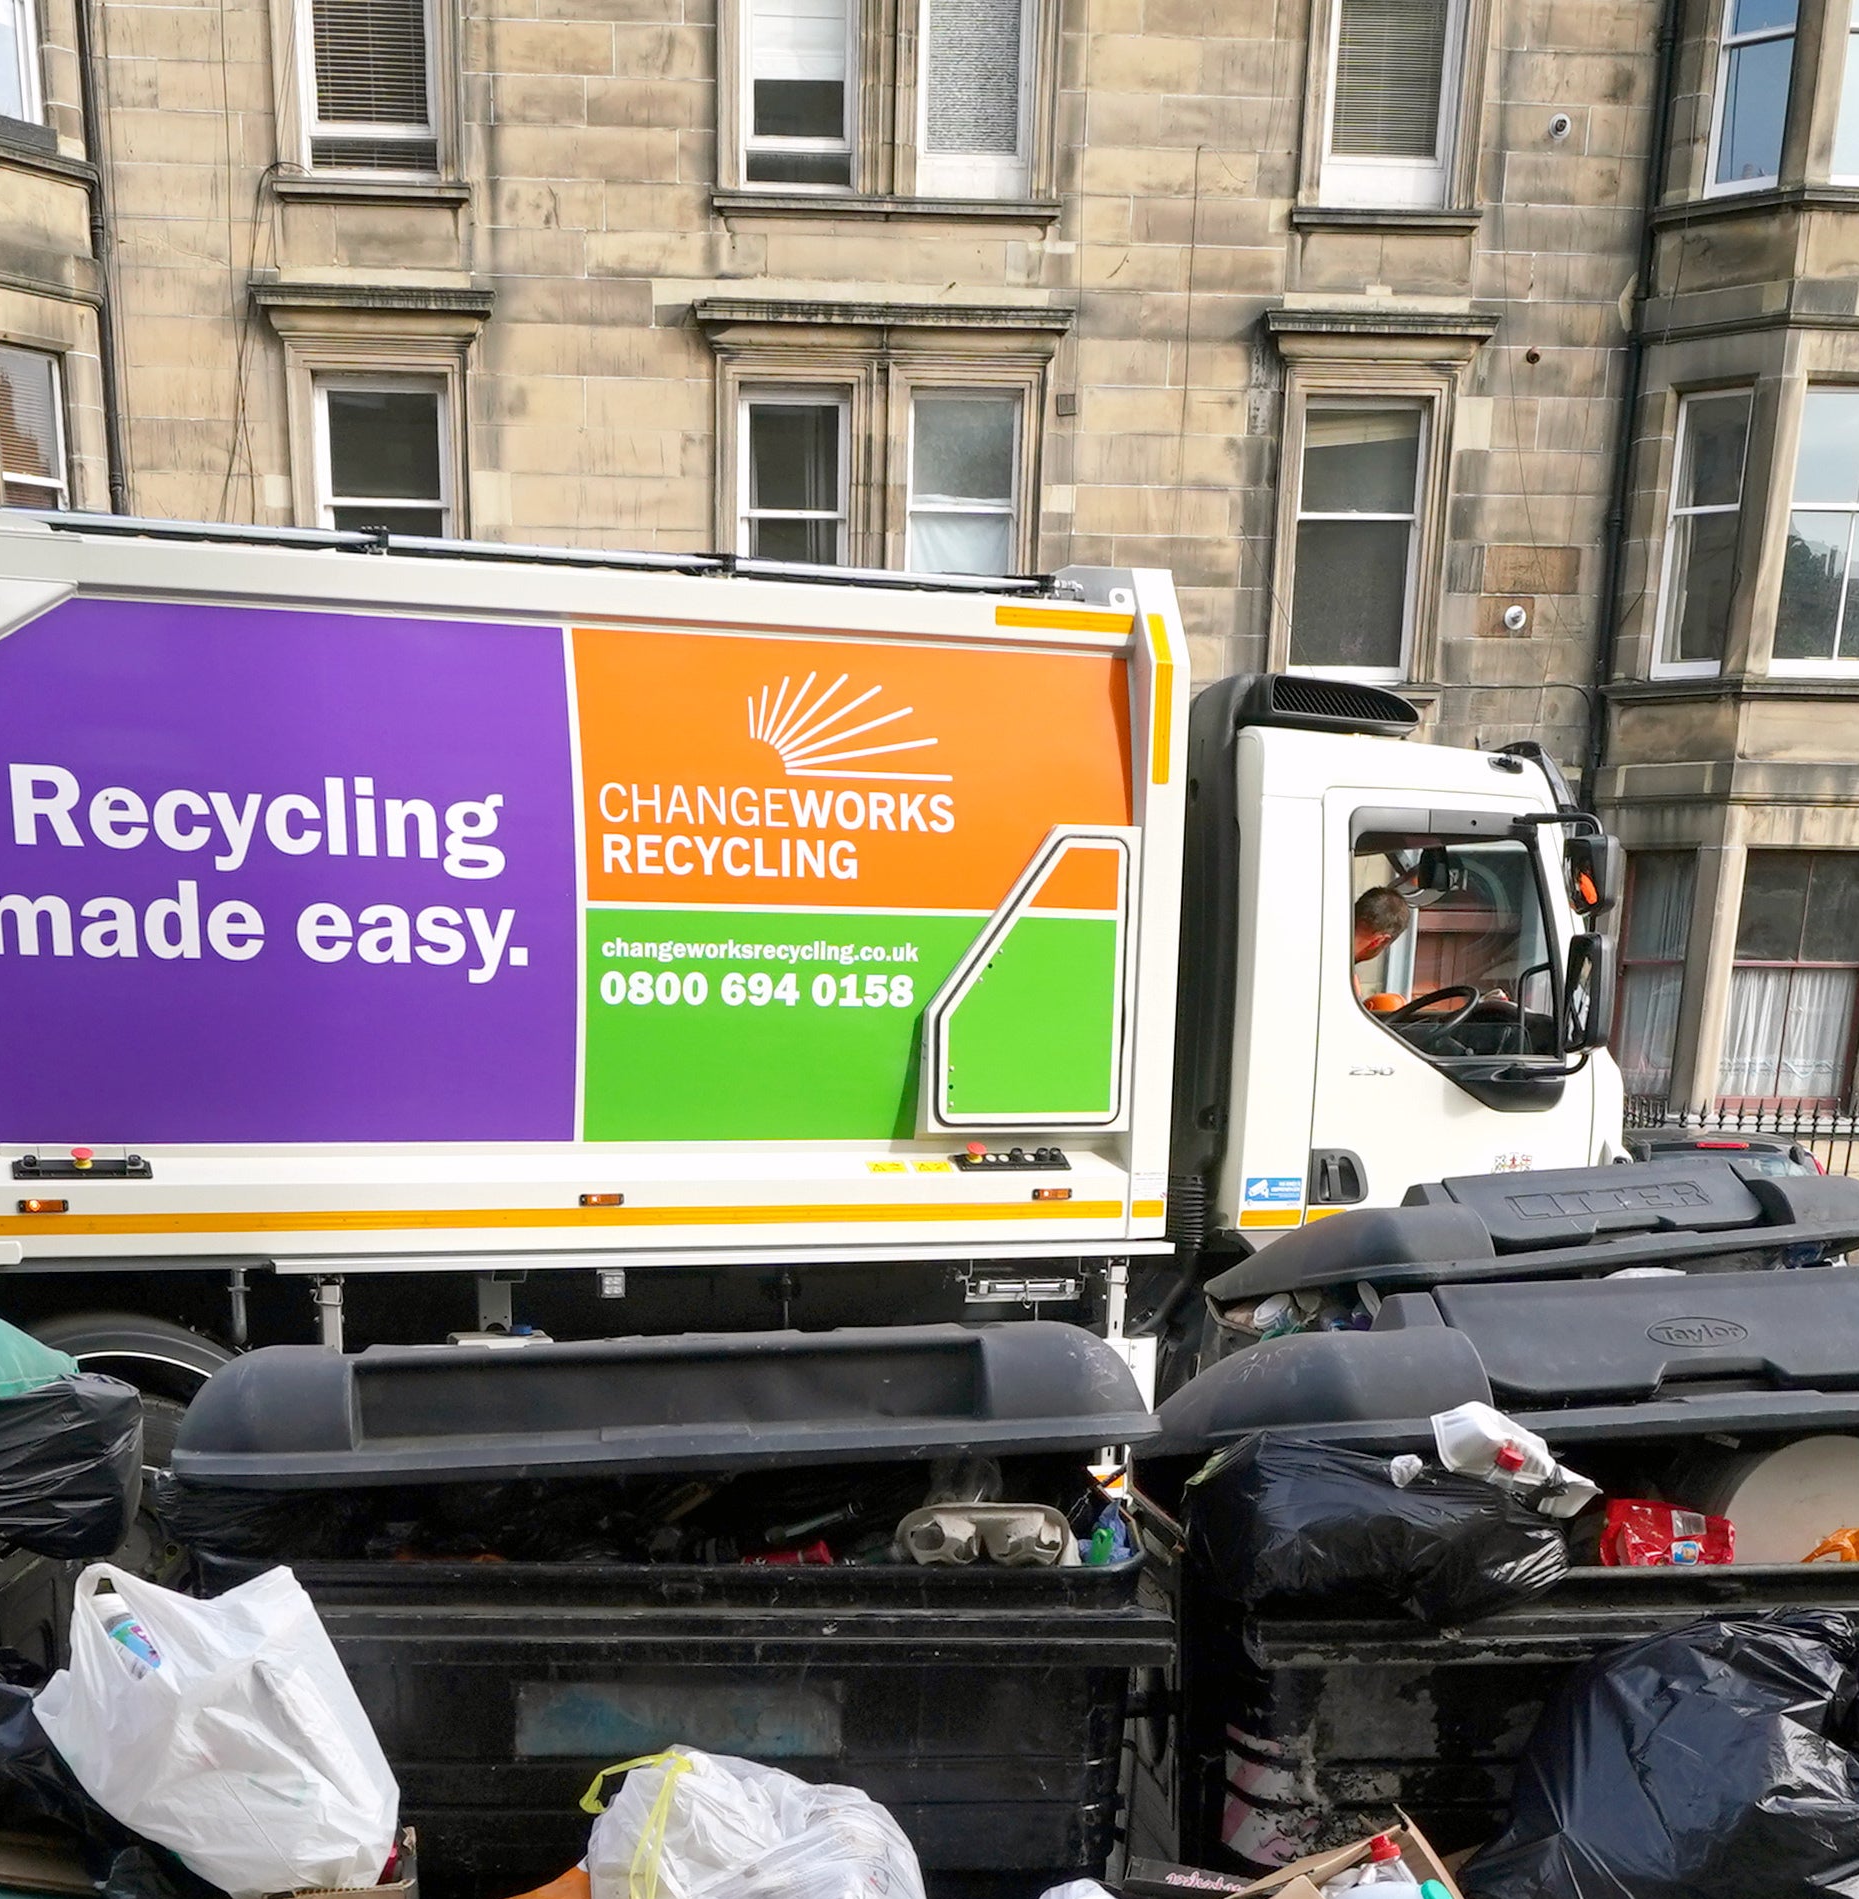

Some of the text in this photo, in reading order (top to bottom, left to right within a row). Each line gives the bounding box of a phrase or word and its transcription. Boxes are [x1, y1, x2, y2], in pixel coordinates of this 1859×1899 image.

[7, 761, 509, 881] Recycling
[598, 781, 957, 835] CHANGEWORKS
[601, 833, 860, 882] RECYCLING
[295, 898, 531, 985] easy.
[600, 935, 920, 967] changeworksrecycling.co.uk
[599, 969, 915, 1010] 0800 694 0158
[1504, 1180, 1713, 1221] LITTER
[1655, 1325, 1740, 1342] Taylor
